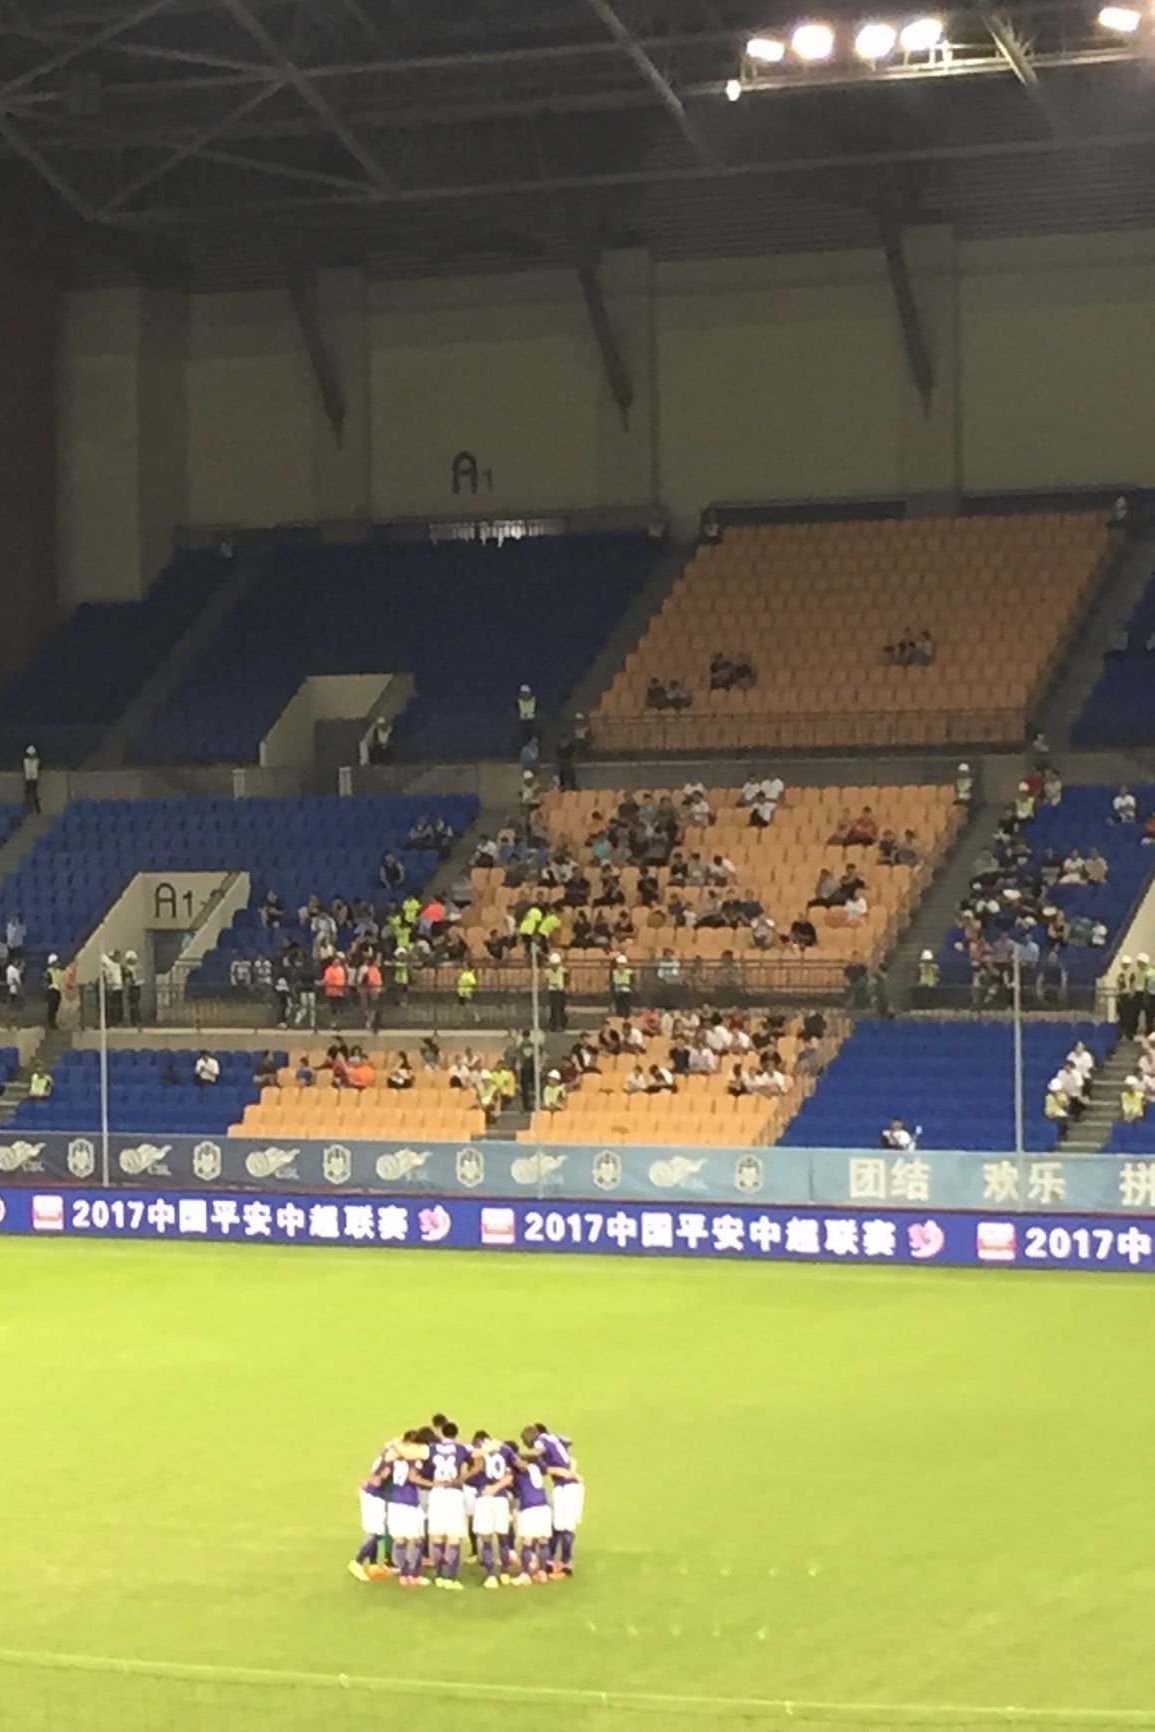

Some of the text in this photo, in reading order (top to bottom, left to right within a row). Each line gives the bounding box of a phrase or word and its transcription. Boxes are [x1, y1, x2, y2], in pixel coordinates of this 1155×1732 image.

[452, 450, 493, 495] A1
[849, 1157, 931, 1201] 团结
[982, 1160, 1066, 1204] 欢乐
